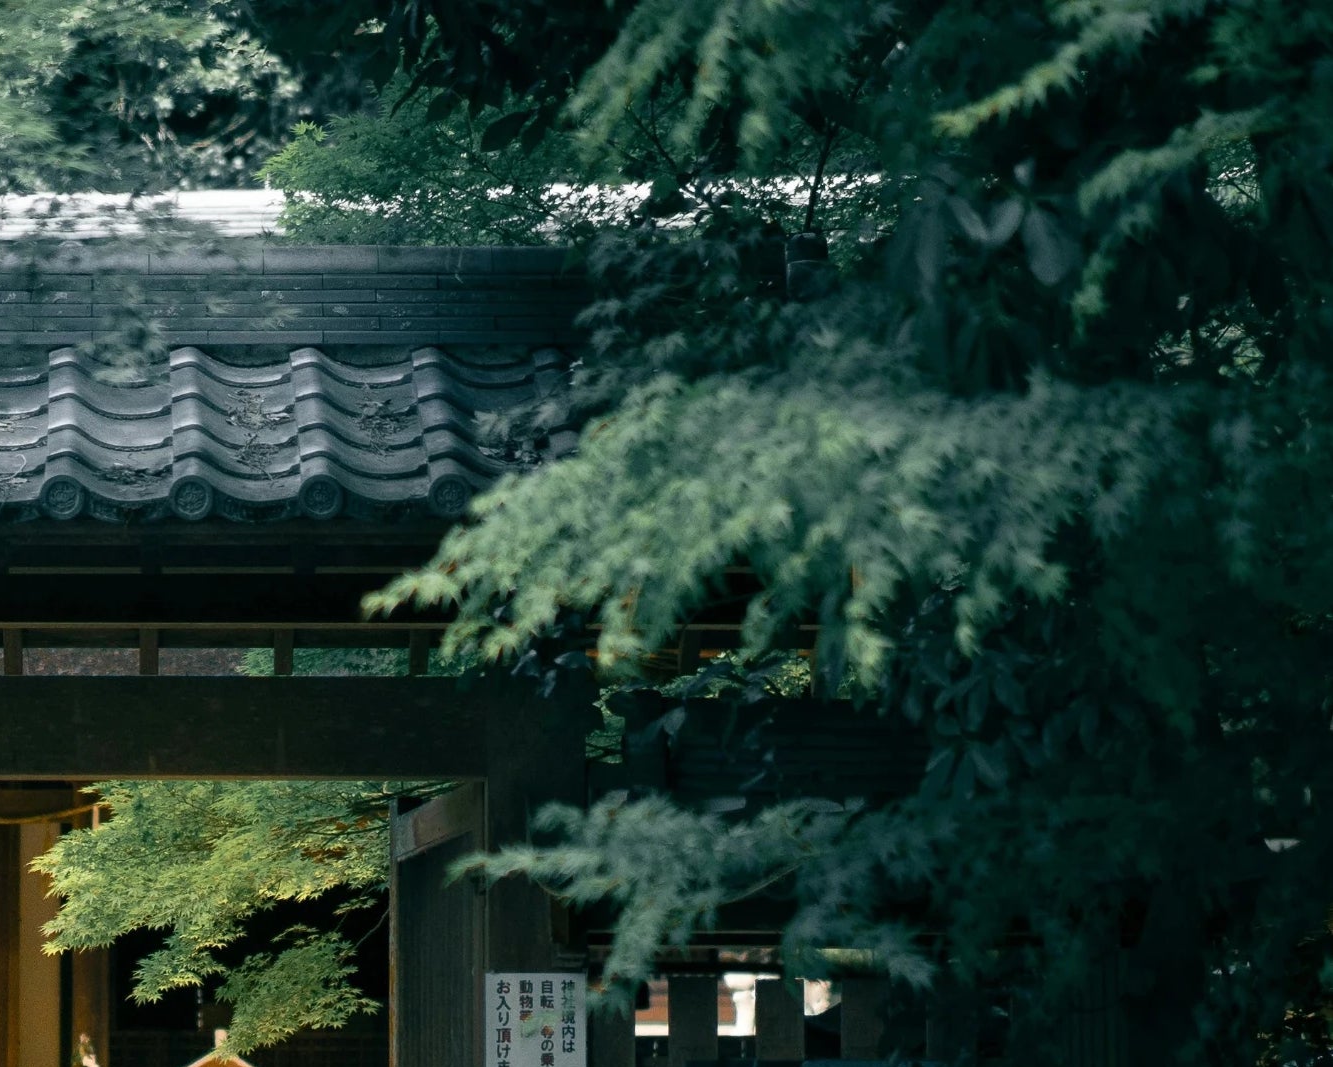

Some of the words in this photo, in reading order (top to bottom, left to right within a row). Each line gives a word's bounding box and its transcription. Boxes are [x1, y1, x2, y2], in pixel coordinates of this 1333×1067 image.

[561, 980, 576, 1053] 神社境内は
